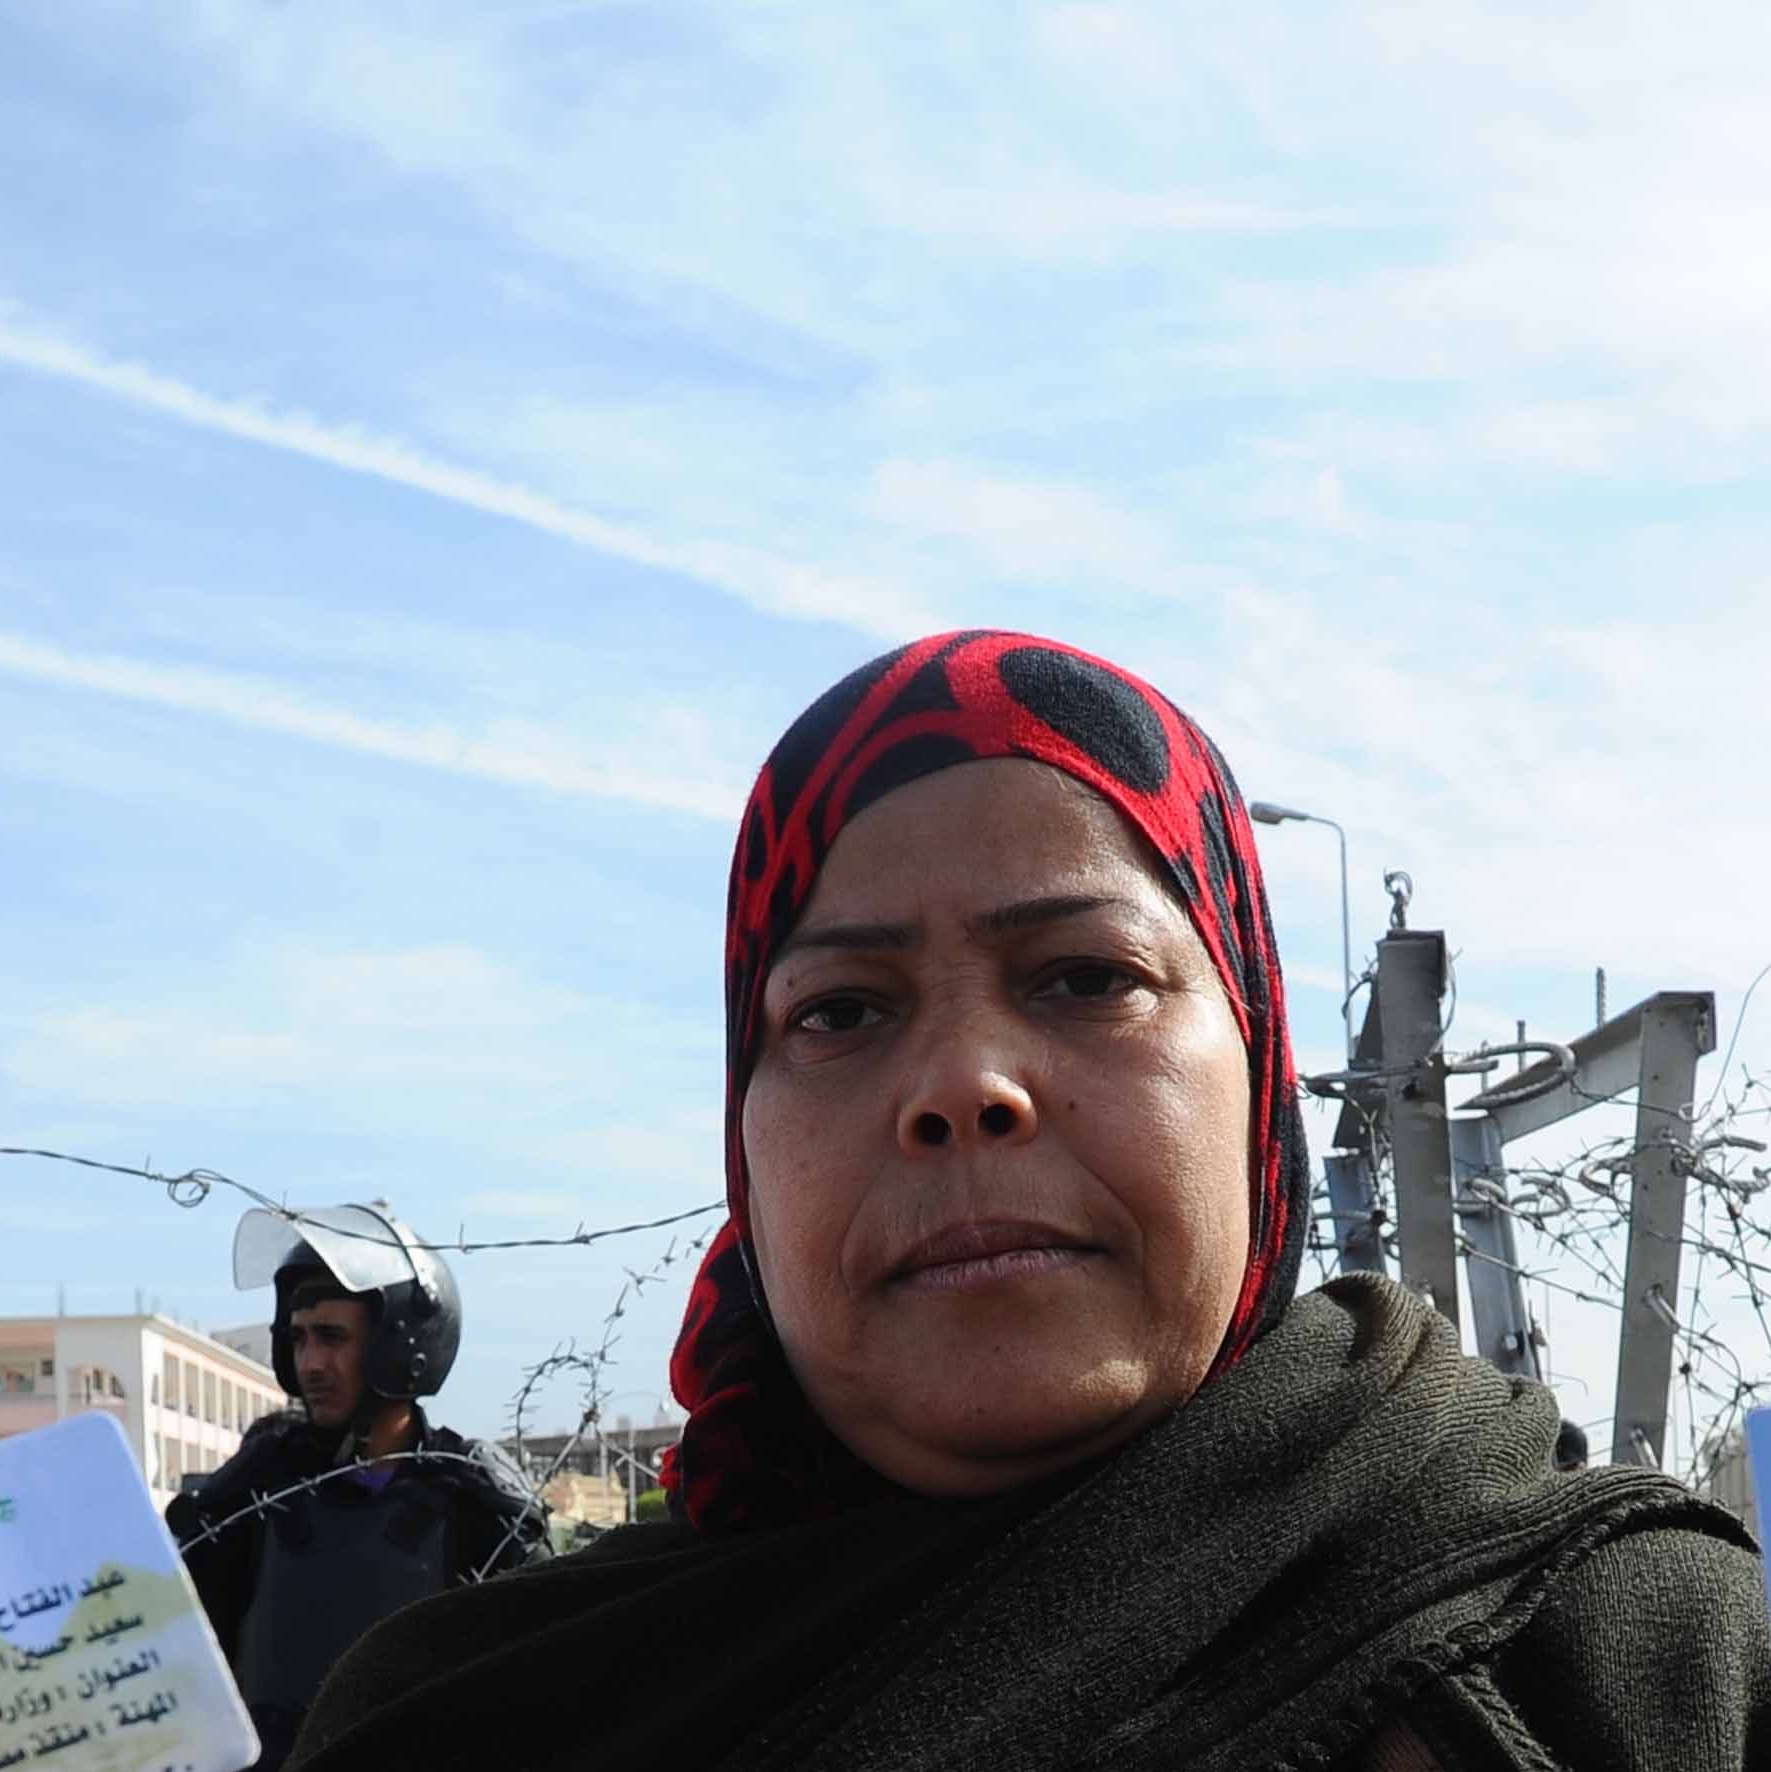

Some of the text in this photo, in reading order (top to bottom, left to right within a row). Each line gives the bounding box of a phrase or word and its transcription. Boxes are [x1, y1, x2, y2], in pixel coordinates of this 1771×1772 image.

[81, 1568, 126, 1598] عبد
[84, 1612, 145, 1645] سعيد
[10, 1635, 76, 1672] حسين
[76, 1648, 163, 1700] العنوان
[108, 1689, 179, 1727] المهنة
[30, 1722, 91, 1757] منقذ
